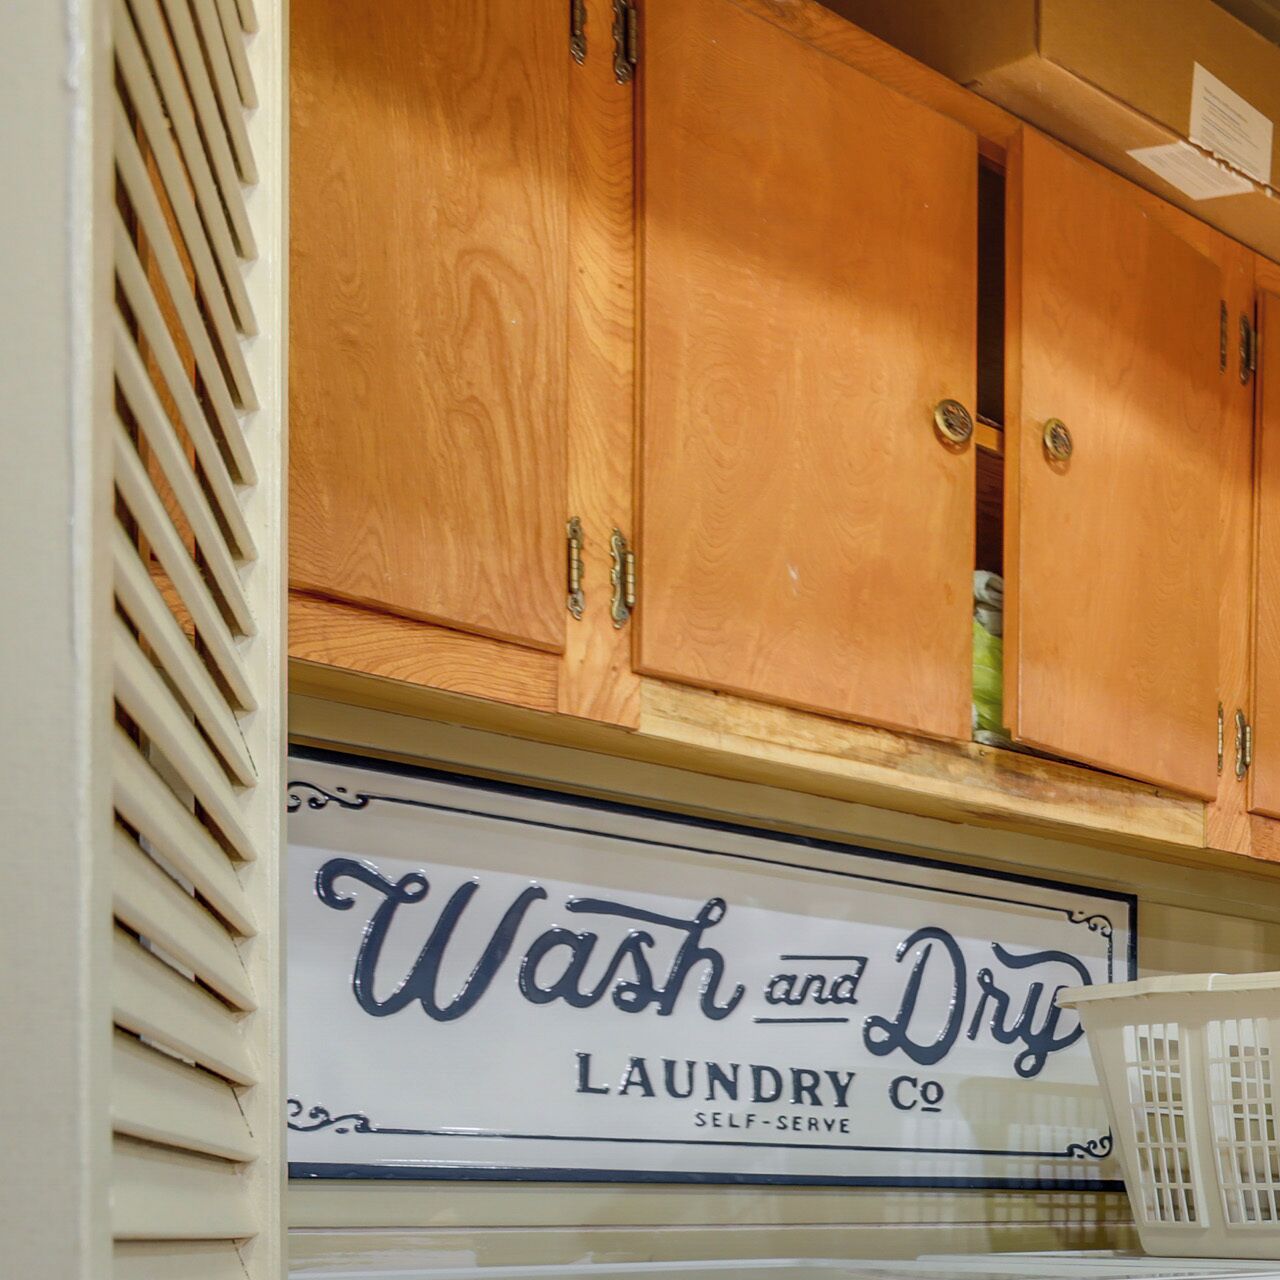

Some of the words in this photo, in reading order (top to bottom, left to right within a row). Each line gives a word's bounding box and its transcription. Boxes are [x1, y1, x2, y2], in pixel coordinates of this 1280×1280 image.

[313, 857, 746, 1021] Wash
[764, 955, 868, 1005] and
[863, 926, 1093, 1079] Dry
[575, 1051, 856, 1108] LAUNDRY
[694, 1111, 851, 1134] SELF-SERVE
